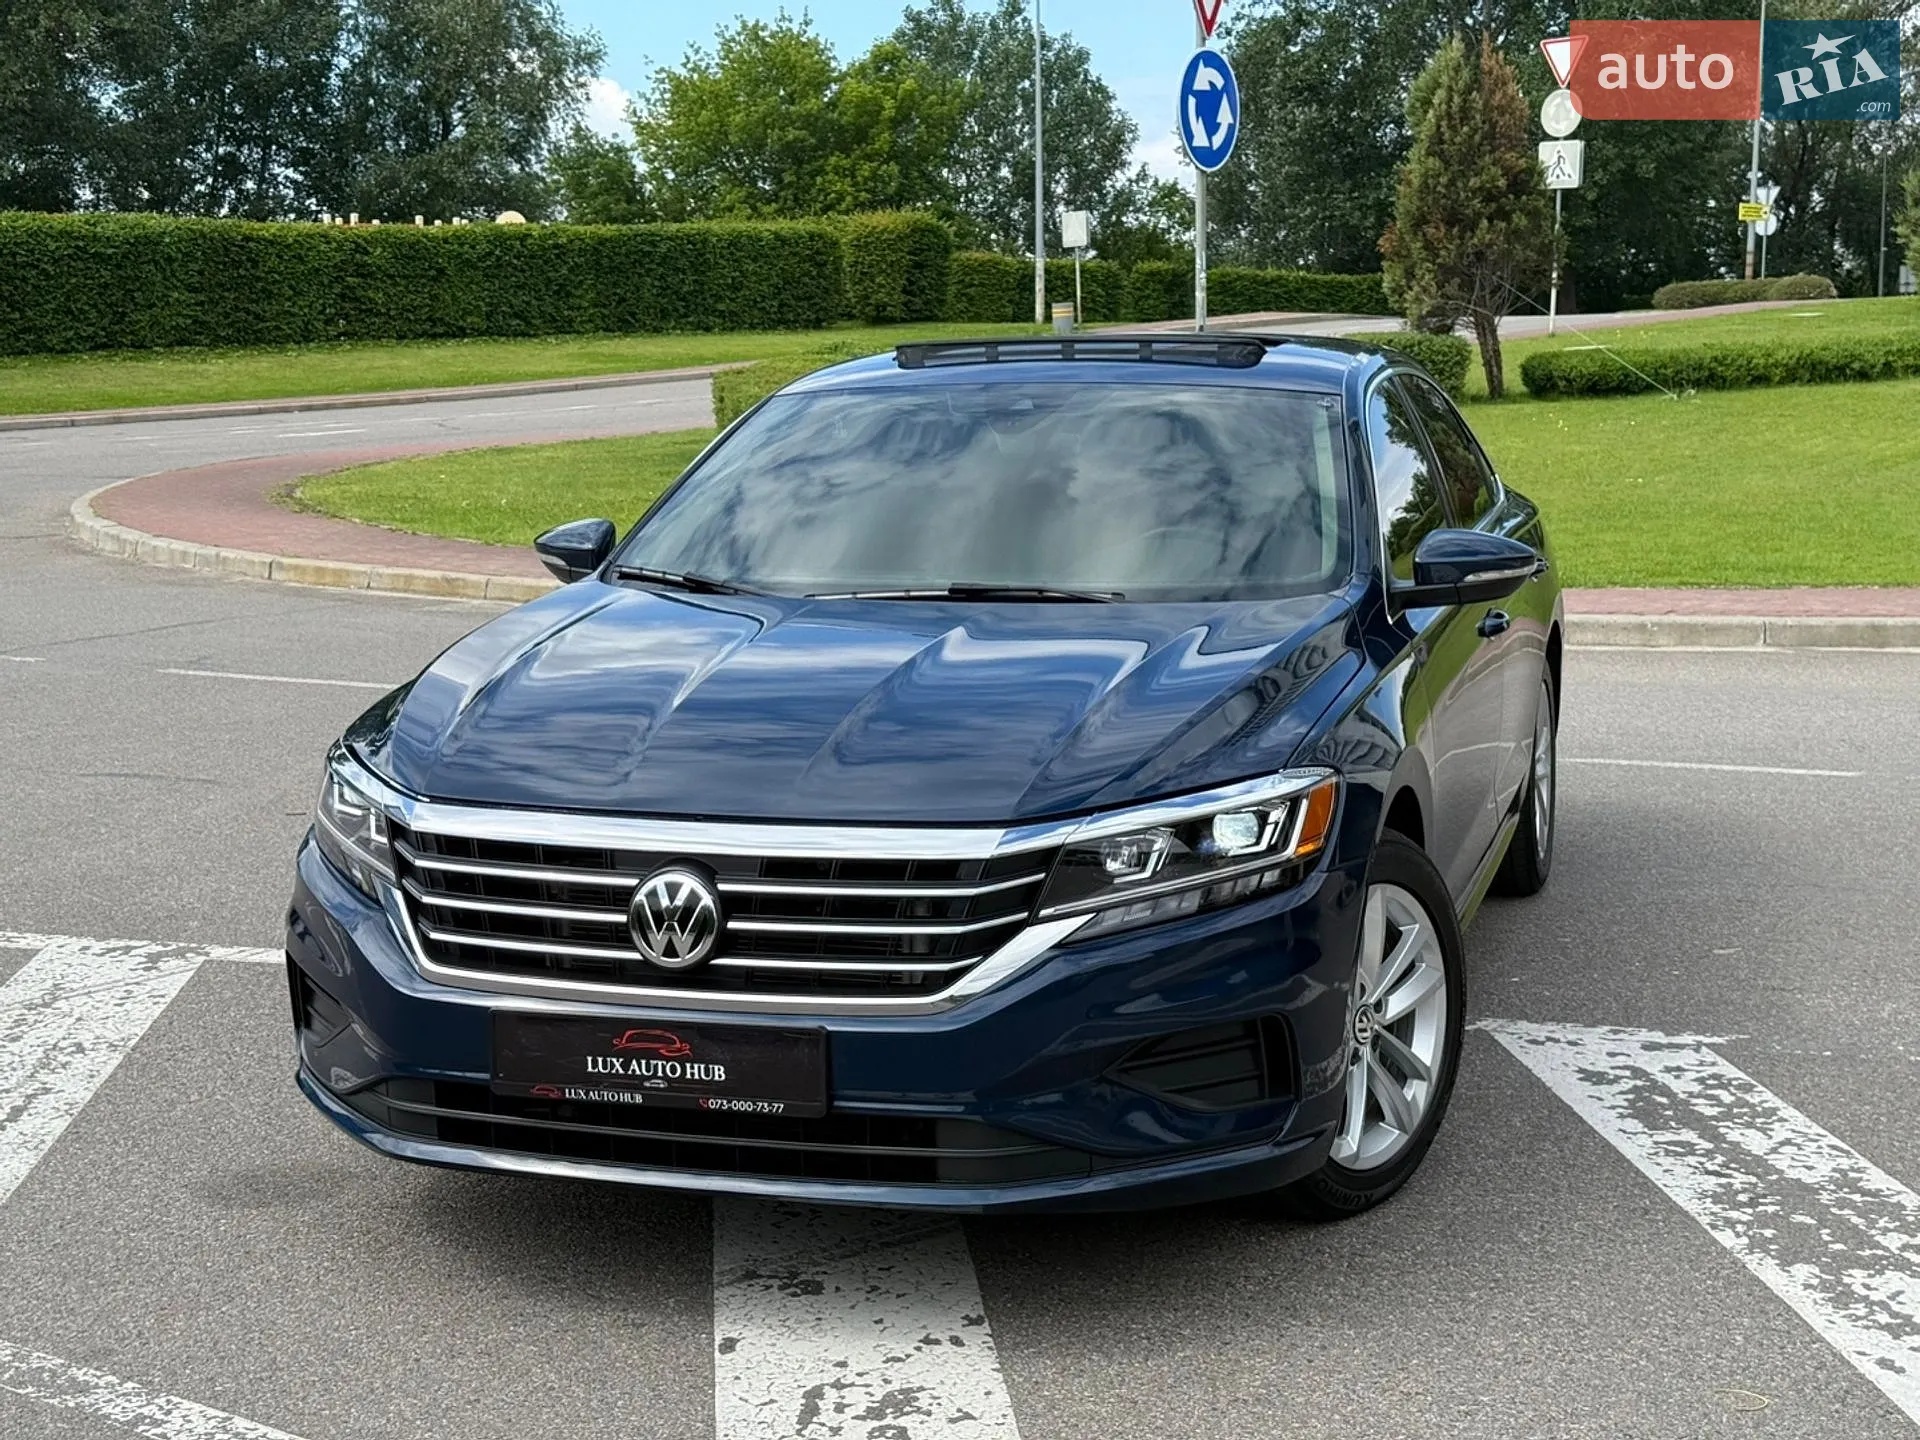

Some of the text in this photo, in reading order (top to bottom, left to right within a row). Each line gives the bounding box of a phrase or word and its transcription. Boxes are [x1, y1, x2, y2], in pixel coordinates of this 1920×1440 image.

[587, 1056, 726, 1081] LUX AUTO HUB
[565, 1088, 643, 1104] LUX AUTO HUB
[708, 1098, 784, 1113] 073-000-73-77
